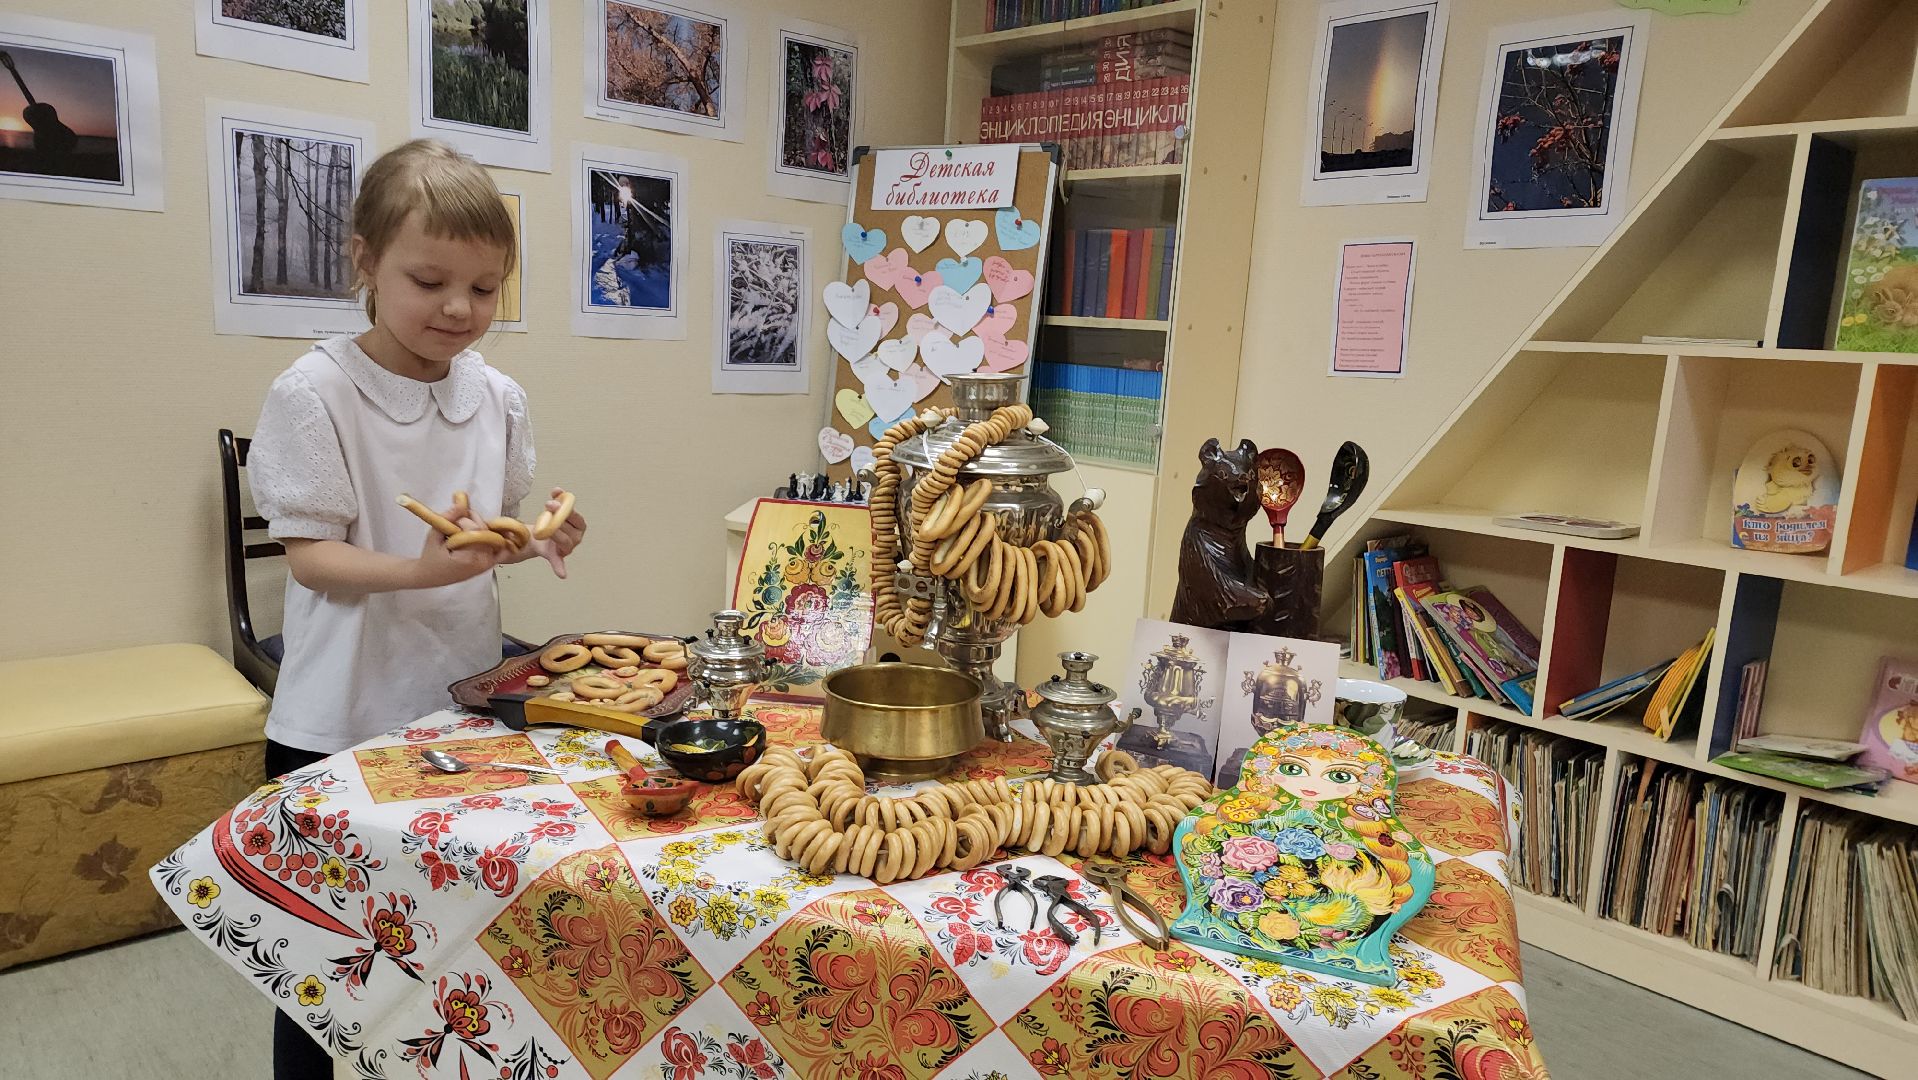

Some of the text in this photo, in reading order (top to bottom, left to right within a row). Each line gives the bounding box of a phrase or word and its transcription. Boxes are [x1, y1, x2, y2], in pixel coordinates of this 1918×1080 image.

[1103, 61, 1110, 72] 30
[1089, 94, 1096, 102] 15
[1106, 93, 1113, 101] 17
[1133, 91, 1140, 99] 20
[1142, 90, 1149, 98] 21
[1152, 88, 1159, 96] 22
[1161, 87, 1169, 95] 23
[1170, 87, 1178, 95] 24
[1181, 85, 1188, 93] 26
[900, 151, 995, 182] Детская
[885, 182, 999, 206] библиотека
[1754, 532, 1769, 541] из
